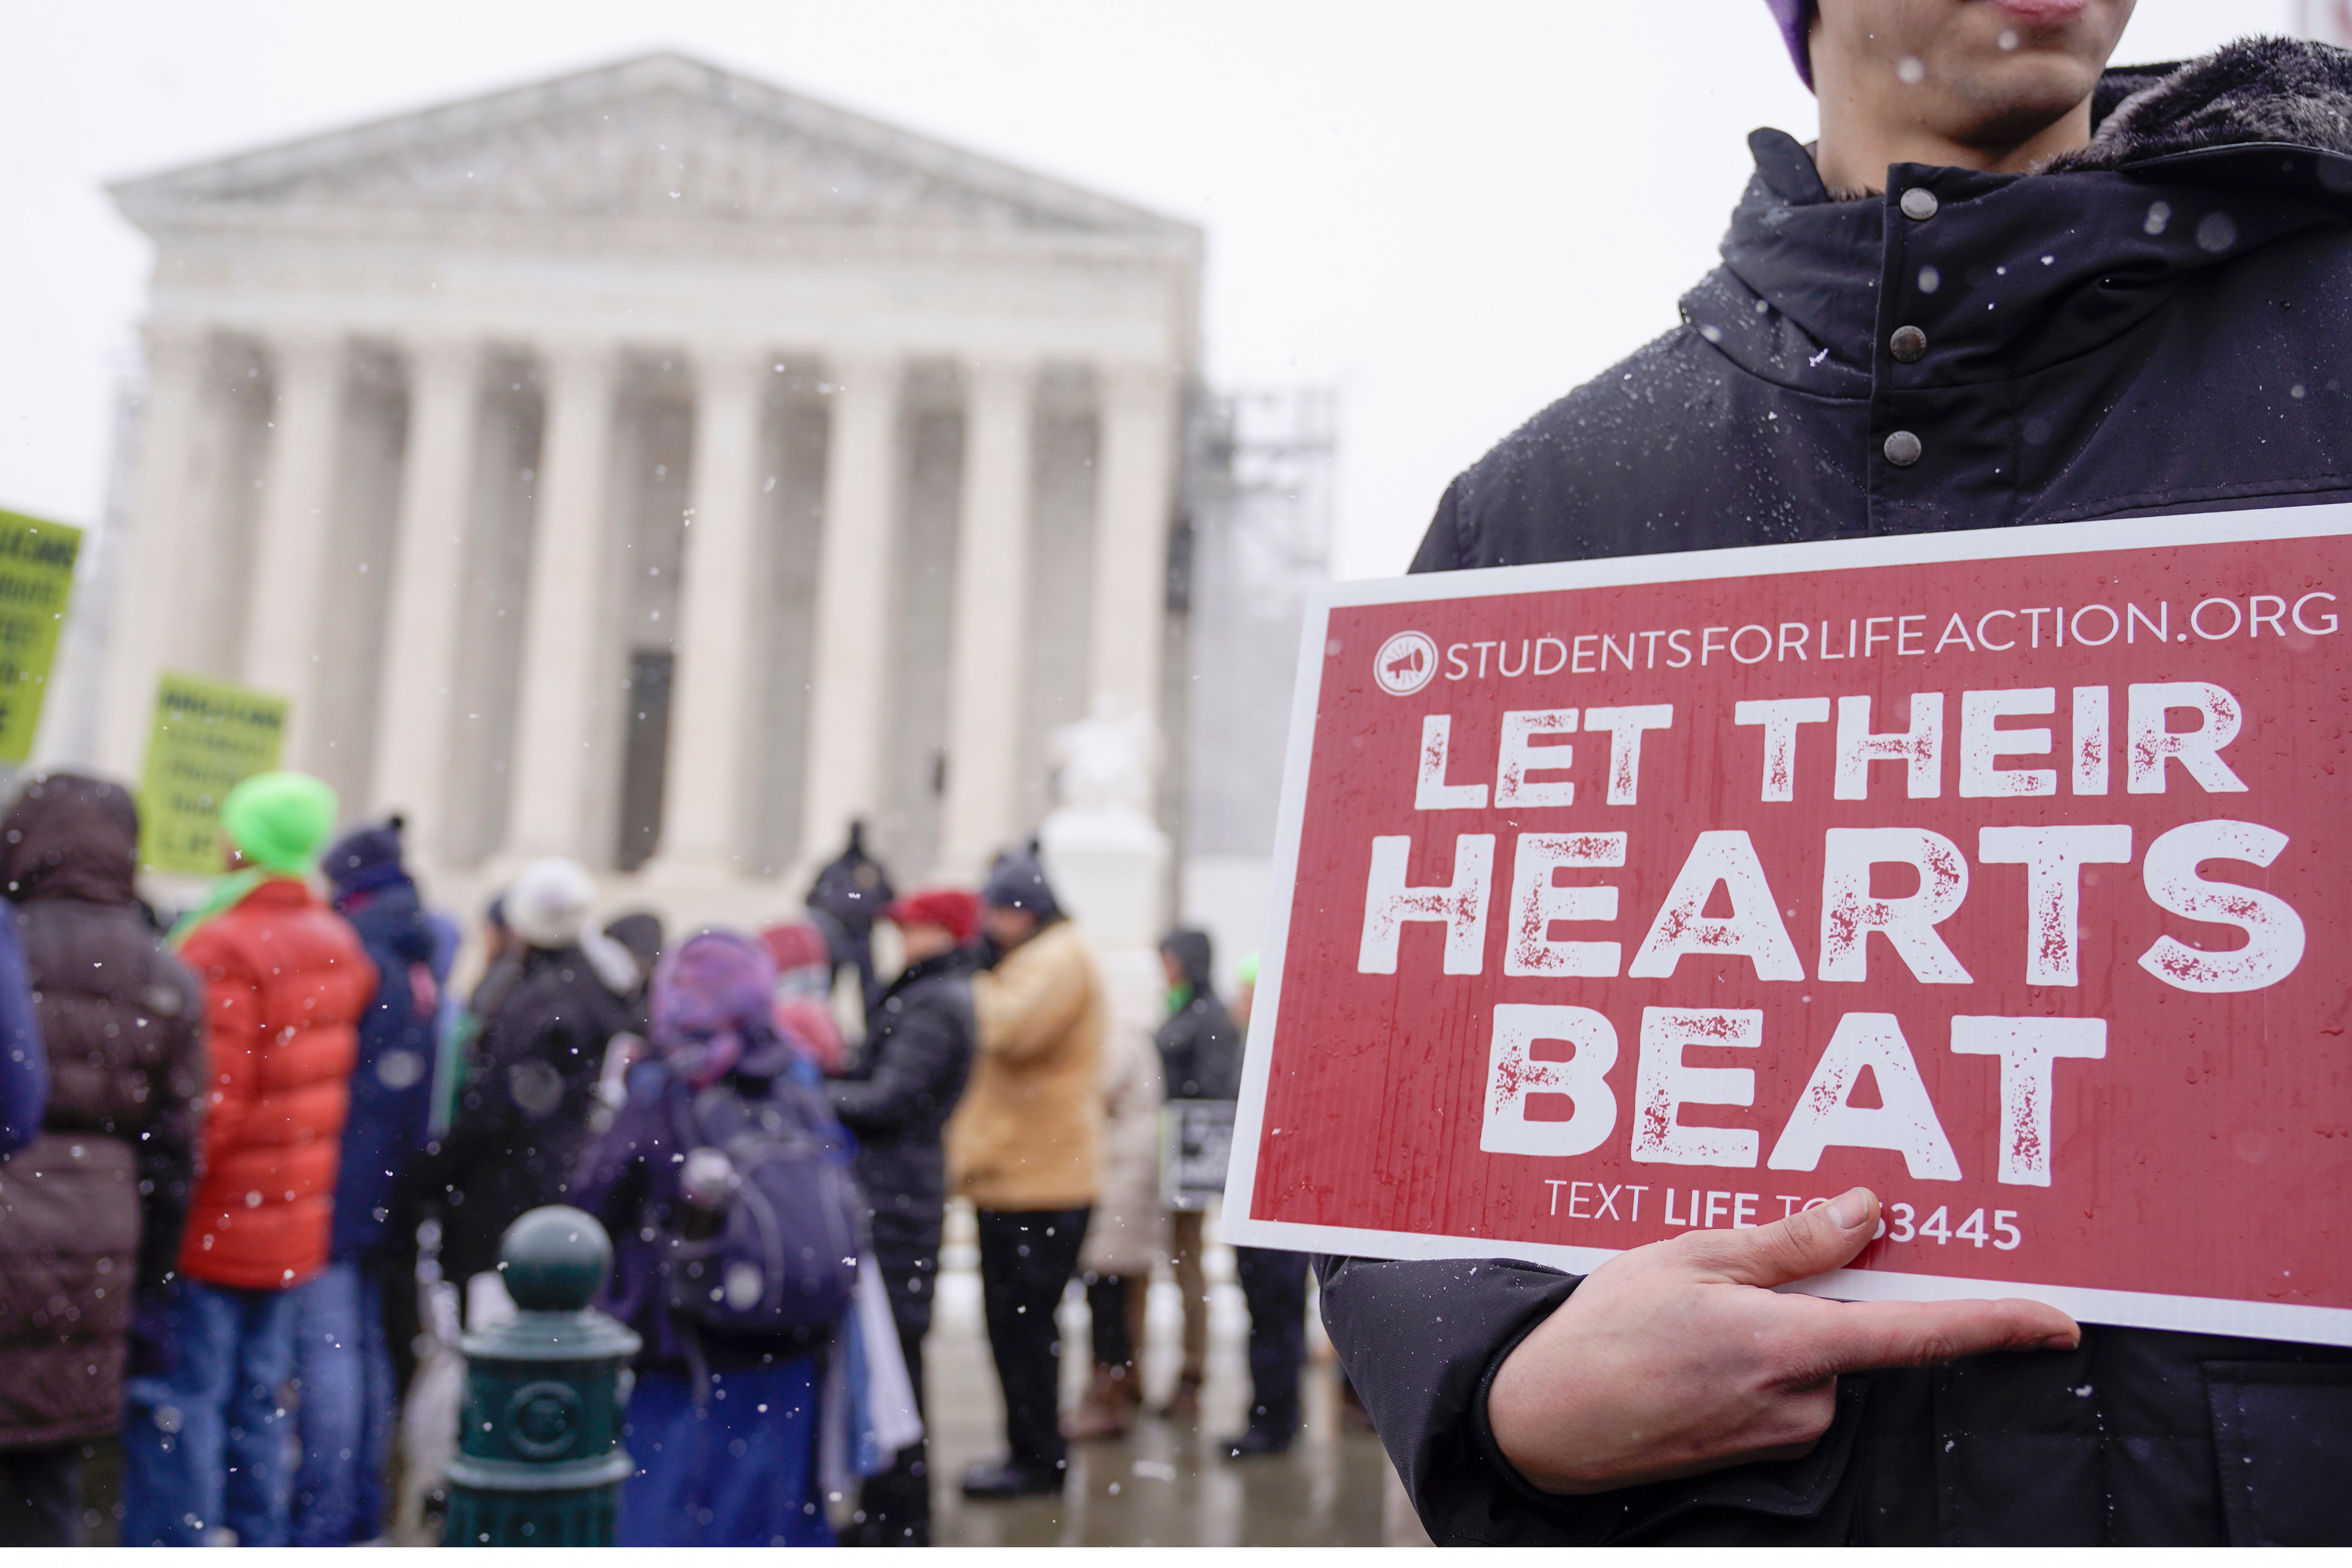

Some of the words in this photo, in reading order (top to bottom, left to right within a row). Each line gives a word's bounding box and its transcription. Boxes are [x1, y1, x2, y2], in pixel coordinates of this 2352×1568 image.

[1413, 703, 1674, 811] LET
[1733, 681, 2249, 802] THEIR
[1357, 819, 2306, 994] HEARTS
[1479, 1003, 2108, 1188] BEAT
[1544, 1179, 1649, 1222] TEXT
[1664, 1188, 1759, 1229] LIFE
